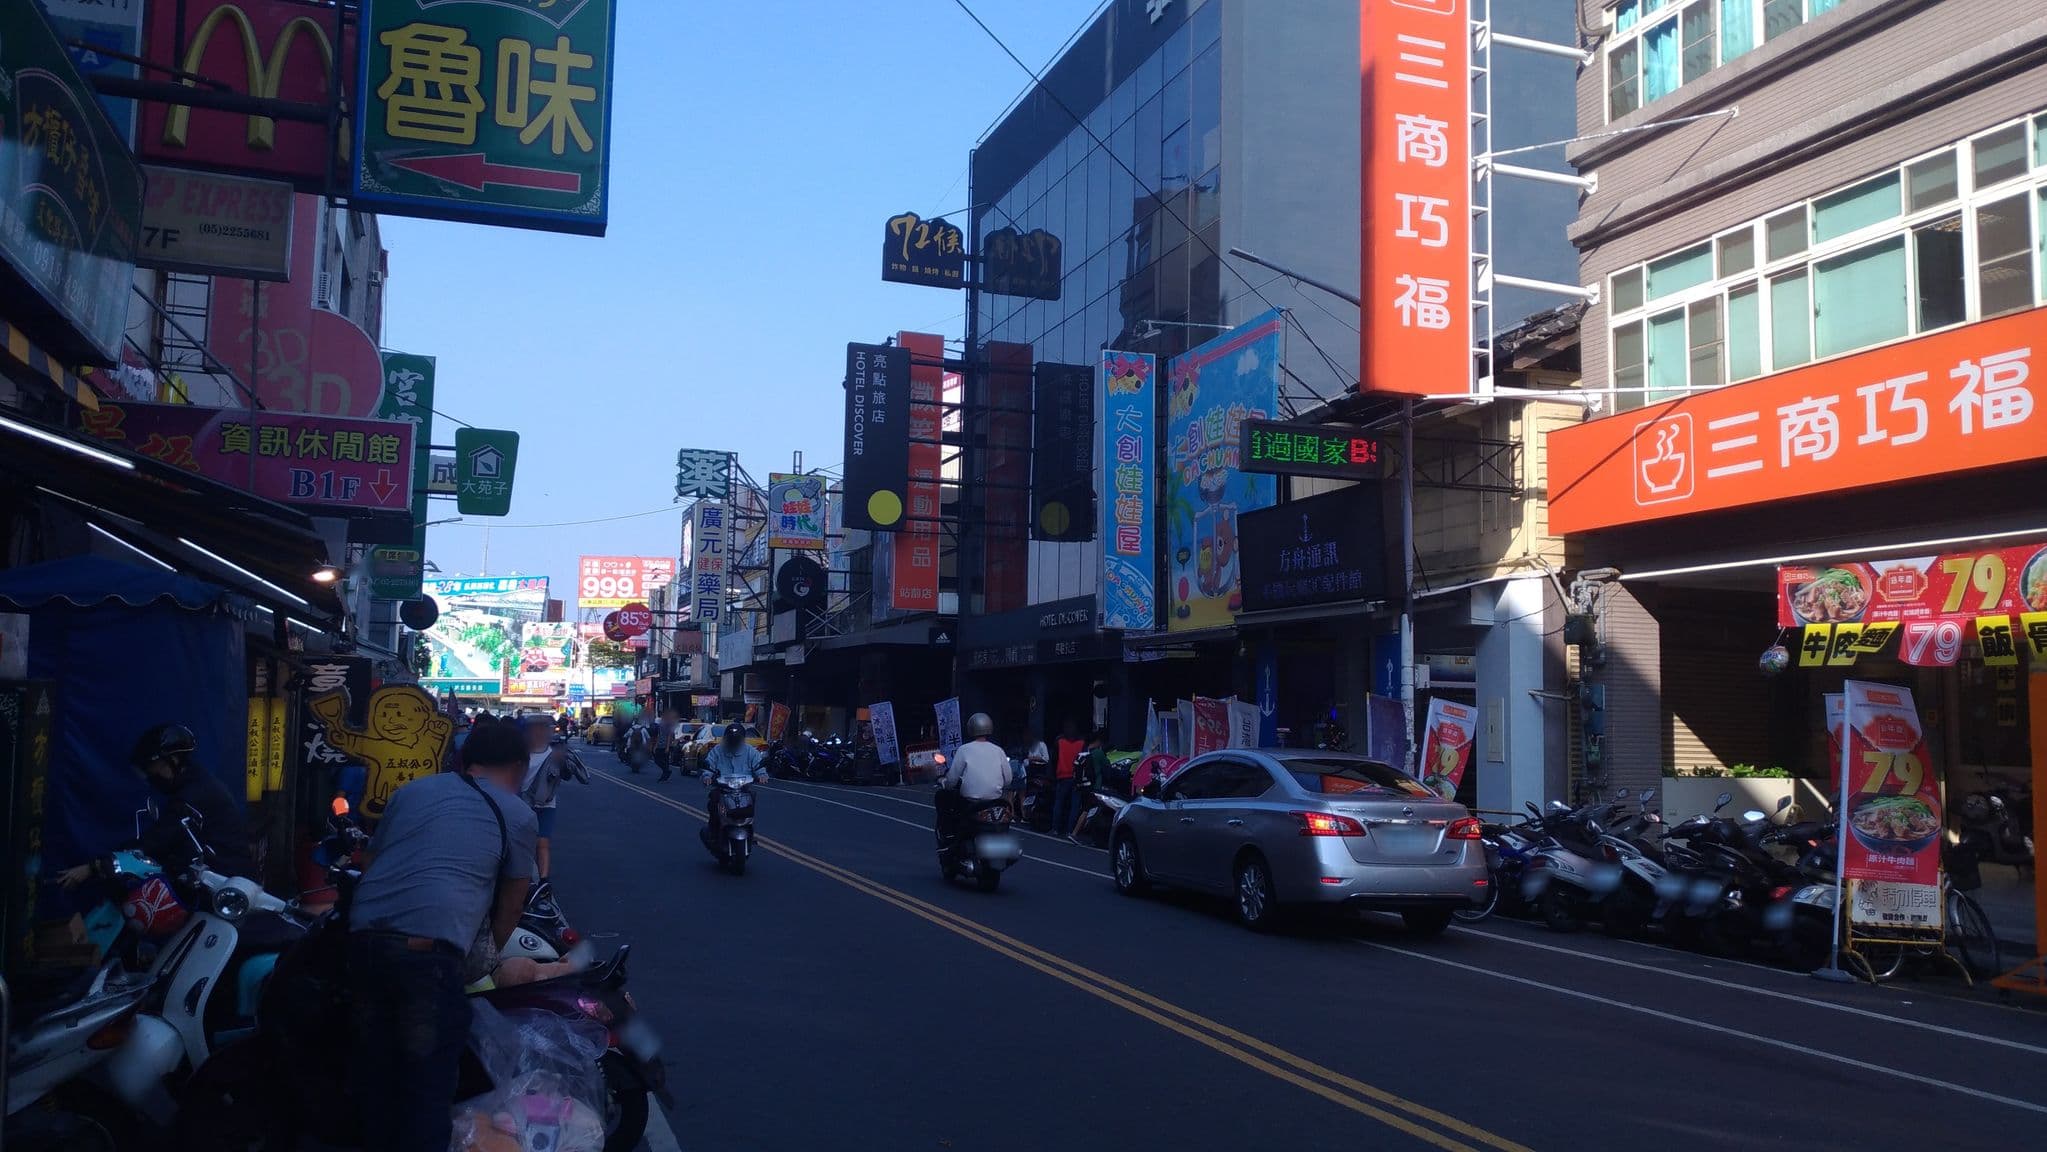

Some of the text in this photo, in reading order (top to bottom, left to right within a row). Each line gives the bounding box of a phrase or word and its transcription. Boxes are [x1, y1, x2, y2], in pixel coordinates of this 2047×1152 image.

[377, 22, 598, 155] 魯味
[1394, 34, 1451, 331] 三商巧福
[143, 224, 180, 248] 7F
[853, 351, 865, 457] HOTEL DISCOVER
[871, 353, 888, 424] 亮點旅店
[1707, 346, 2034, 481] 三商巧福
[288, 468, 361, 502] B1F
[461, 480, 509, 497] 大苑子
[1116, 404, 1144, 553] 大創娃娃屋
[781, 515, 818, 532] 時代
[696, 506, 723, 620] 廣元 健保 藥局
[1942, 554, 2007, 613] 79
[582, 576, 634, 598] 999
[899, 586, 932, 599] 站前店
[1908, 621, 1961, 664] 79
[1979, 625, 2015, 657] 飯
[1860, 750, 1925, 796] 79
